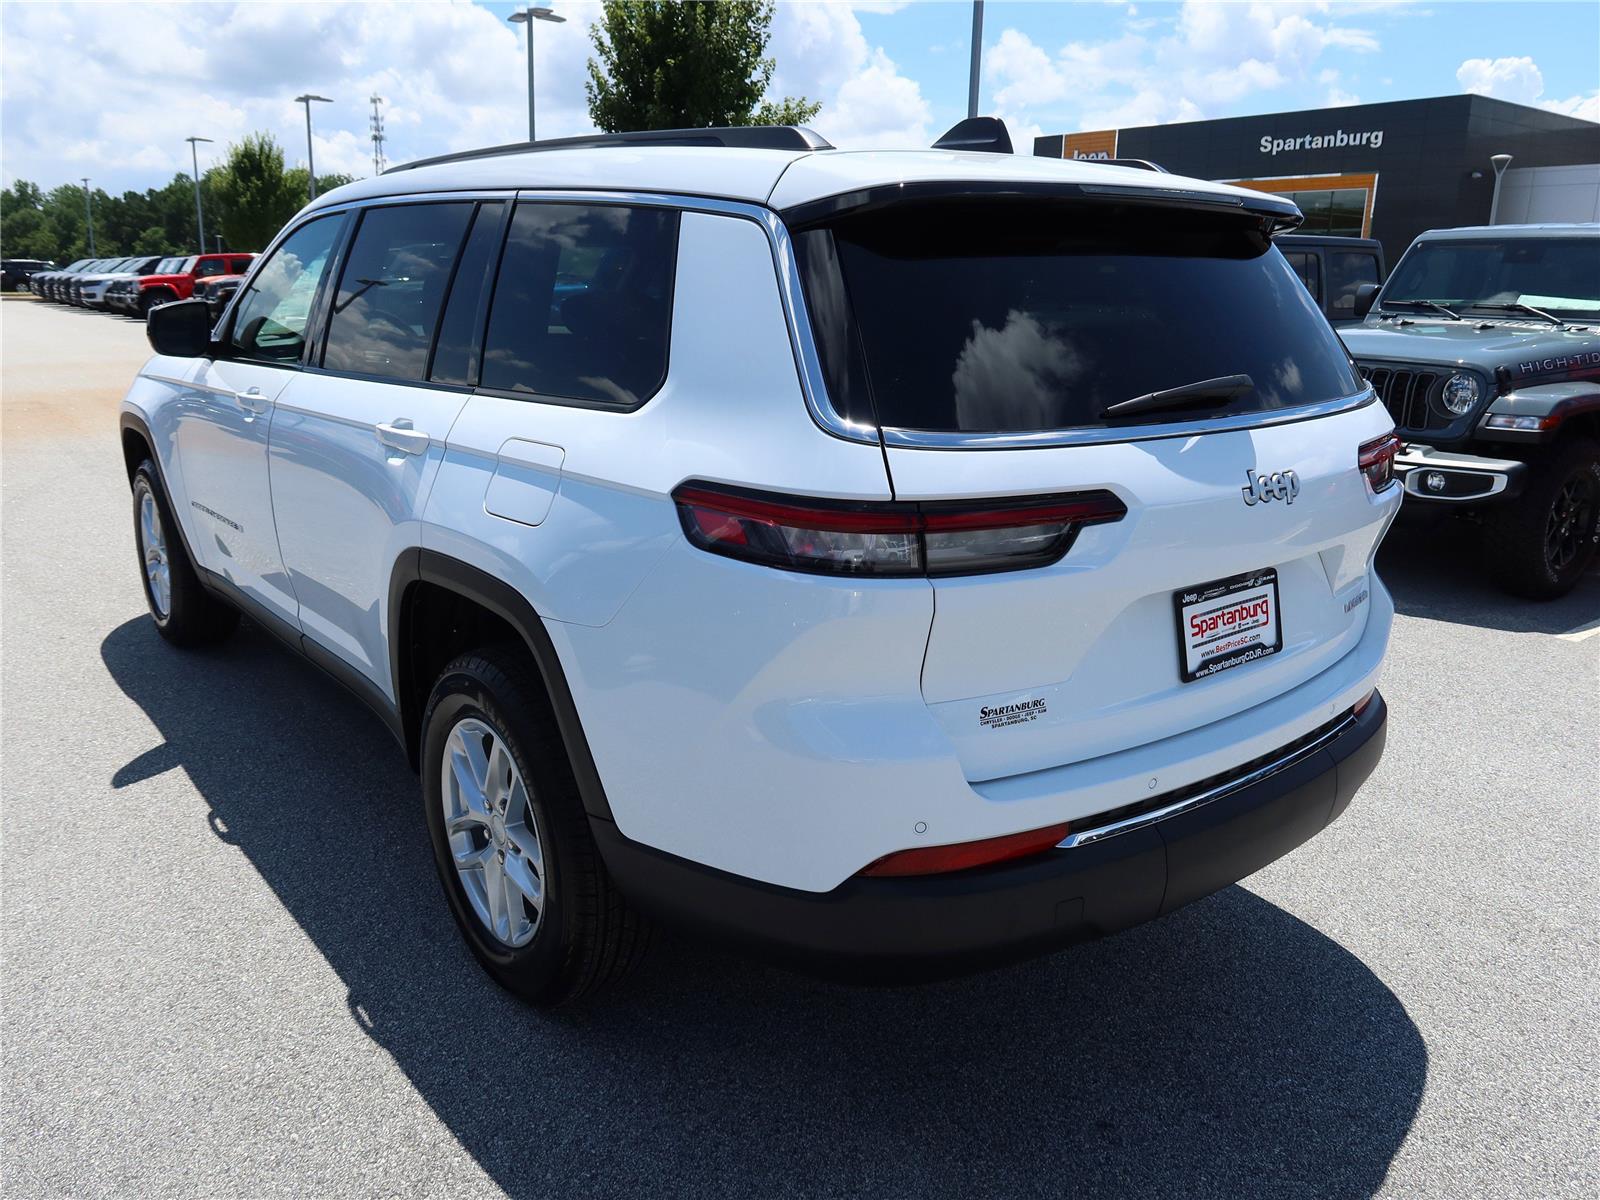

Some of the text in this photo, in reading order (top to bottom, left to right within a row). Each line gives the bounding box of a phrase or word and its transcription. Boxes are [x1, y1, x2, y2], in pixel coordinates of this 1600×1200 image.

[1259, 129, 1384, 156] Spartanburg
[1242, 469, 1300, 506] Jeep
[1182, 592, 1198, 604] Jeep
[1190, 599, 1269, 638] Spartanburg
[1200, 633, 1261, 659] www.BestPriceSC.com
[1195, 647, 1275, 678] www.SpartanburgCDJR.com
[979, 698, 1046, 719] SPARTANBURG
